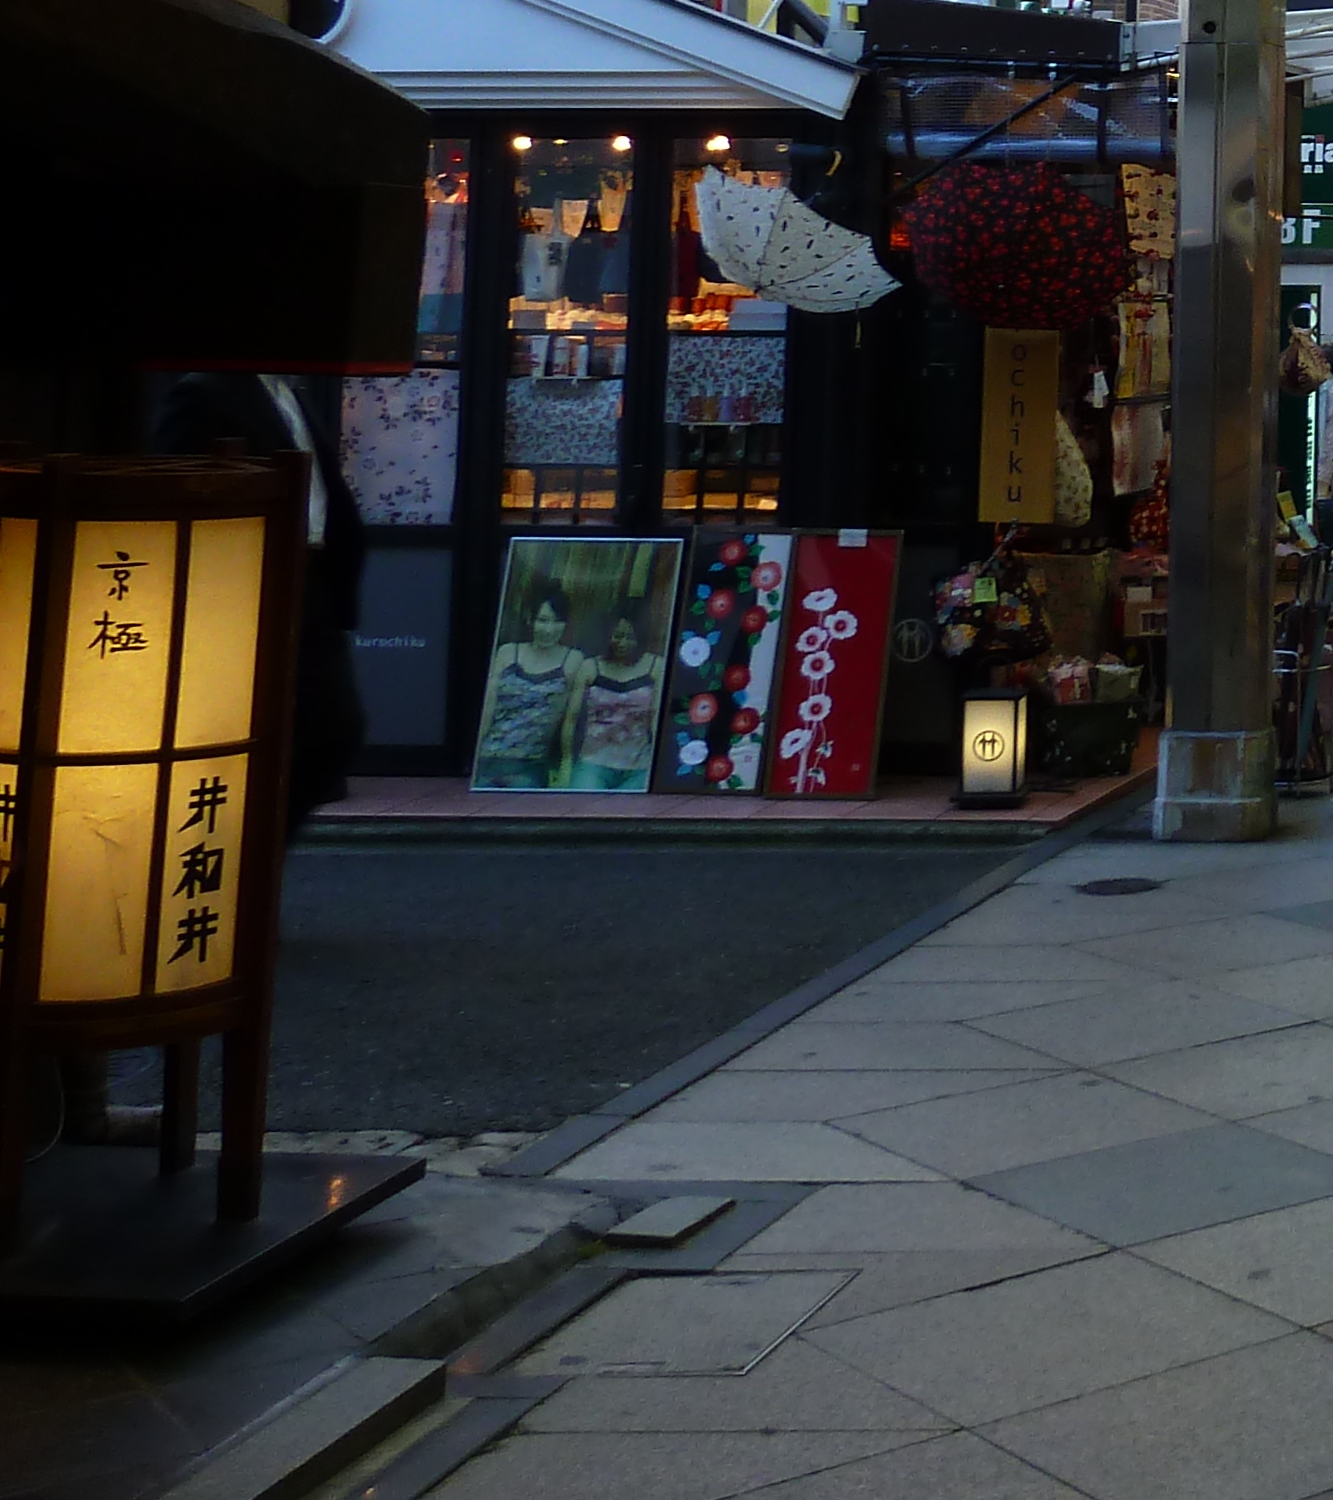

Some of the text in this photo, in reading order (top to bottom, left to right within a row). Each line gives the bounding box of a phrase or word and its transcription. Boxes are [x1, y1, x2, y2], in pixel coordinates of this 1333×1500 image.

[86, 550, 150, 660] 京極
[167, 775, 229, 966] 井和井
